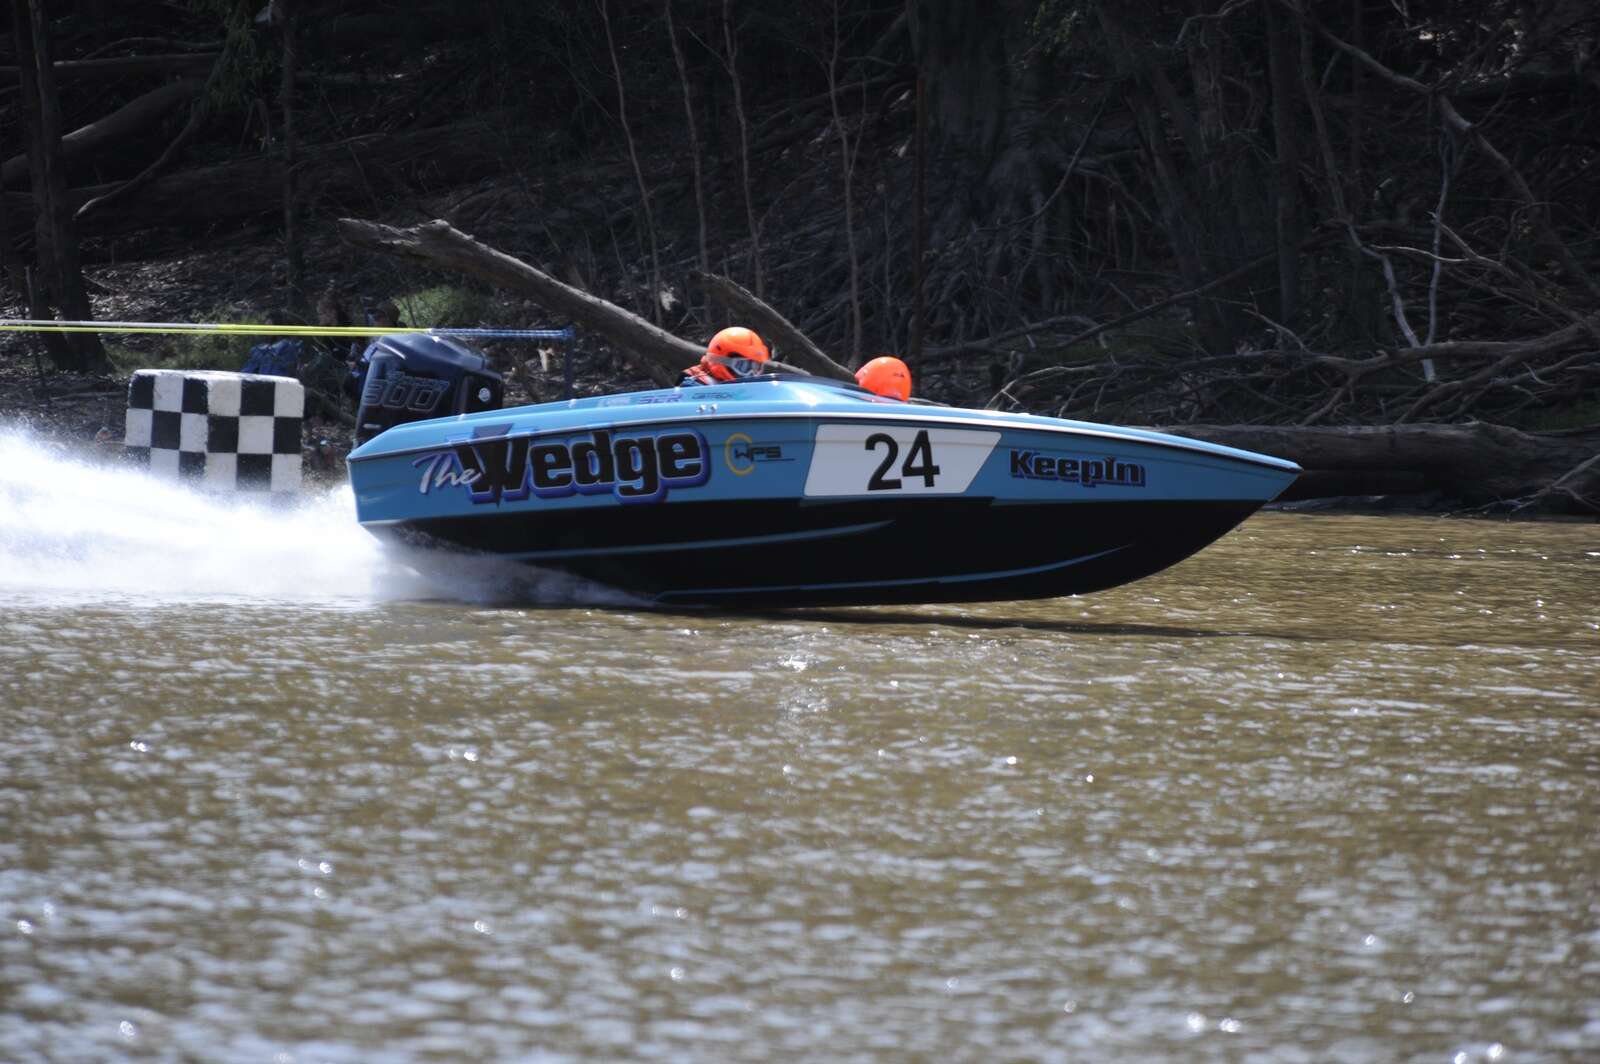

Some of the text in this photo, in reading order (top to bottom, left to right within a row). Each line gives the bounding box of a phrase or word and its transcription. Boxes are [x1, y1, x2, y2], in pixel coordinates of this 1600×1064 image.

[411, 424, 709, 505] The Wedge
[864, 429, 940, 491] 24
